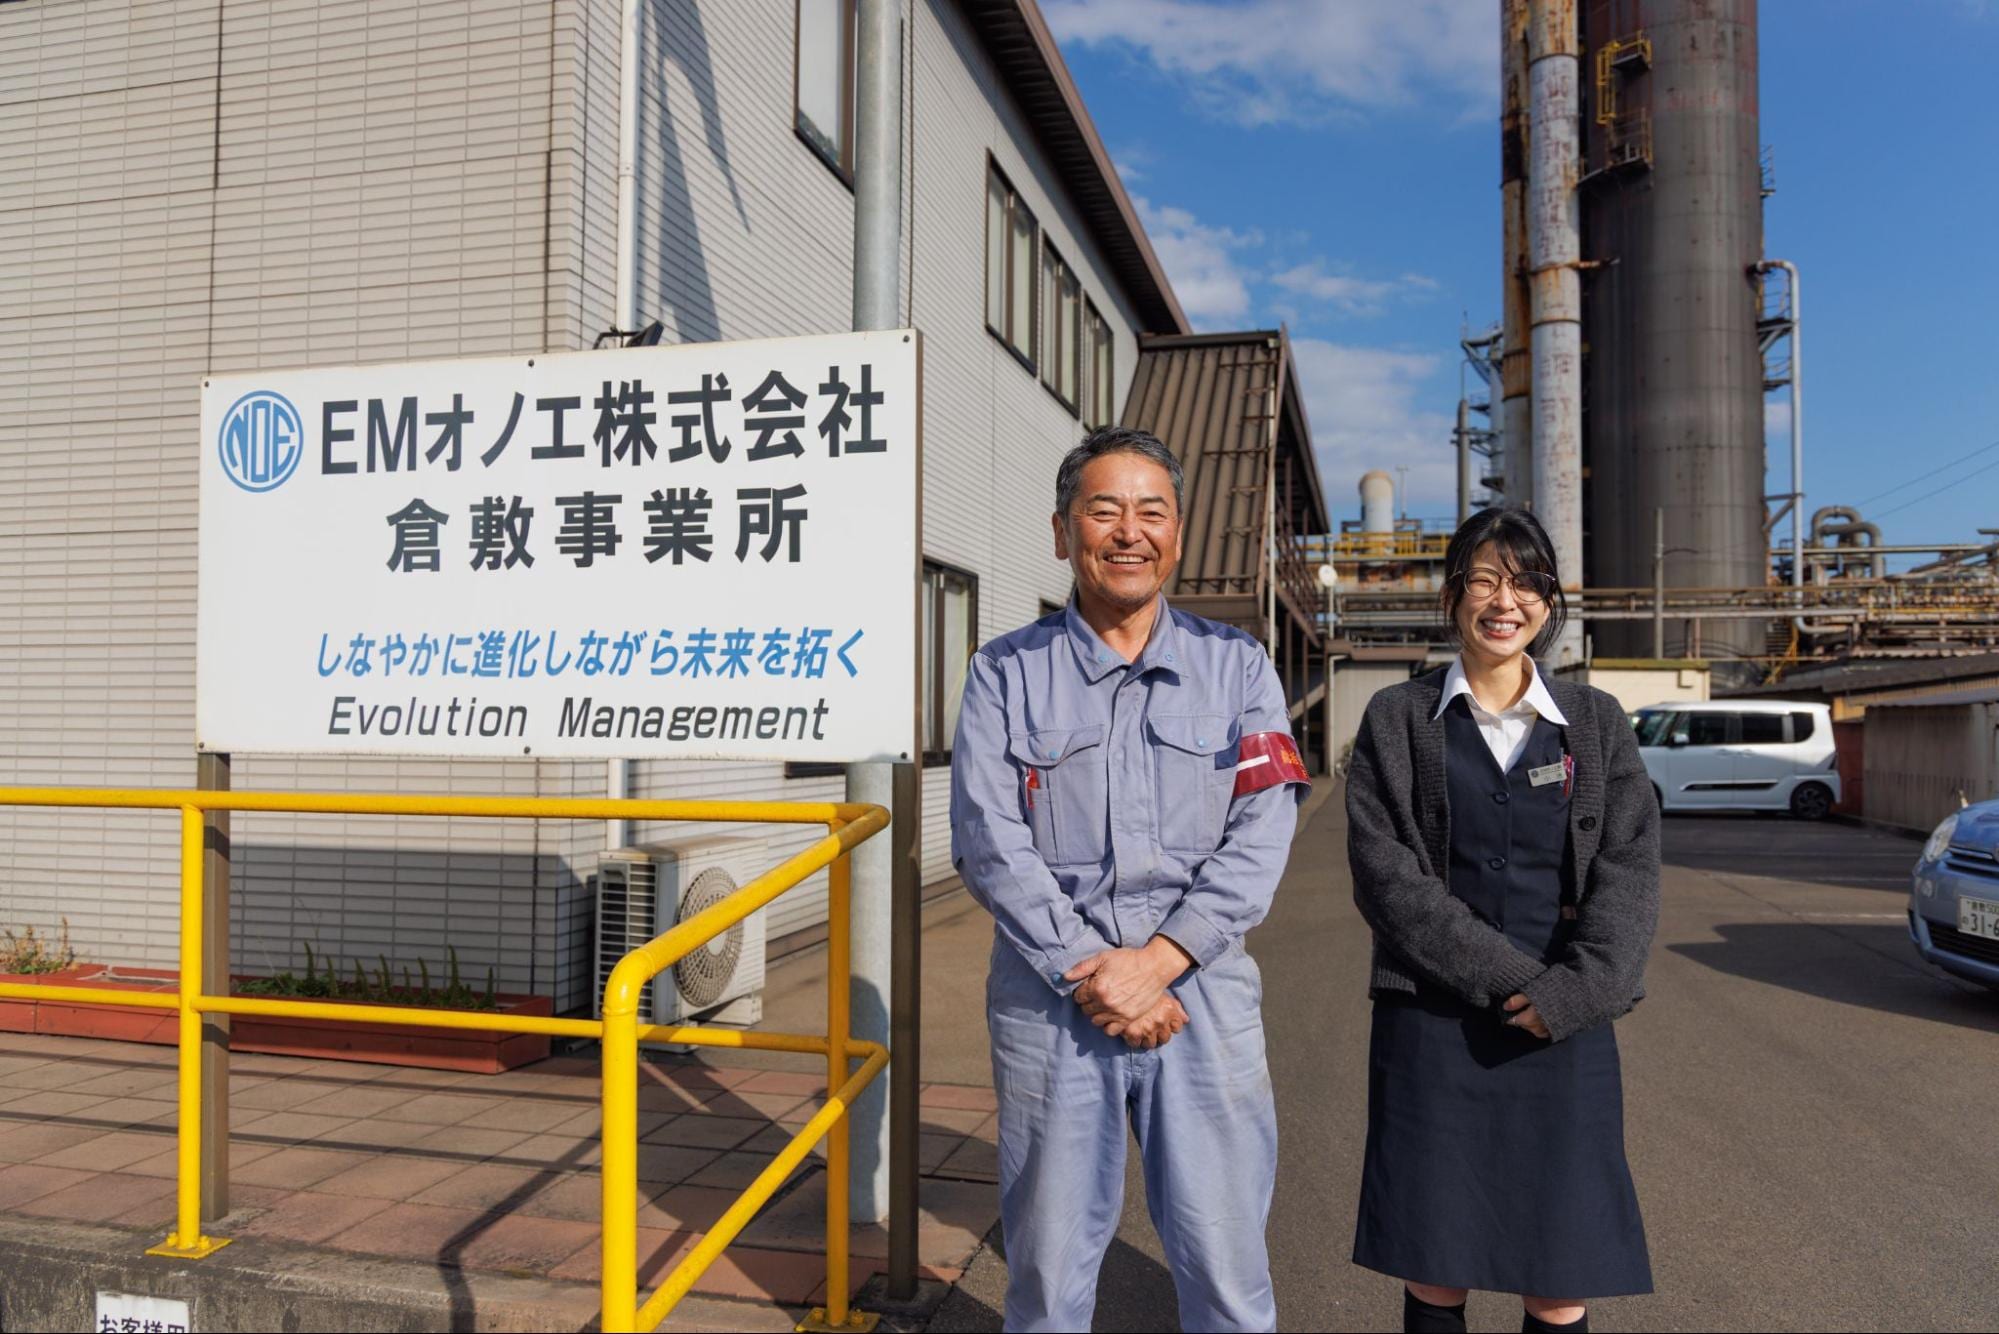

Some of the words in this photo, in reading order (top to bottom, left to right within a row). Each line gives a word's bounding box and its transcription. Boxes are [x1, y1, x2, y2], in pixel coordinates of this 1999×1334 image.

[387, 483, 808, 573] 倉敷事業所
[317, 627, 865, 679] しなやかに進化しながら未来を拓く
[328, 697, 528, 737] Evolution
[557, 698, 830, 742] Management
